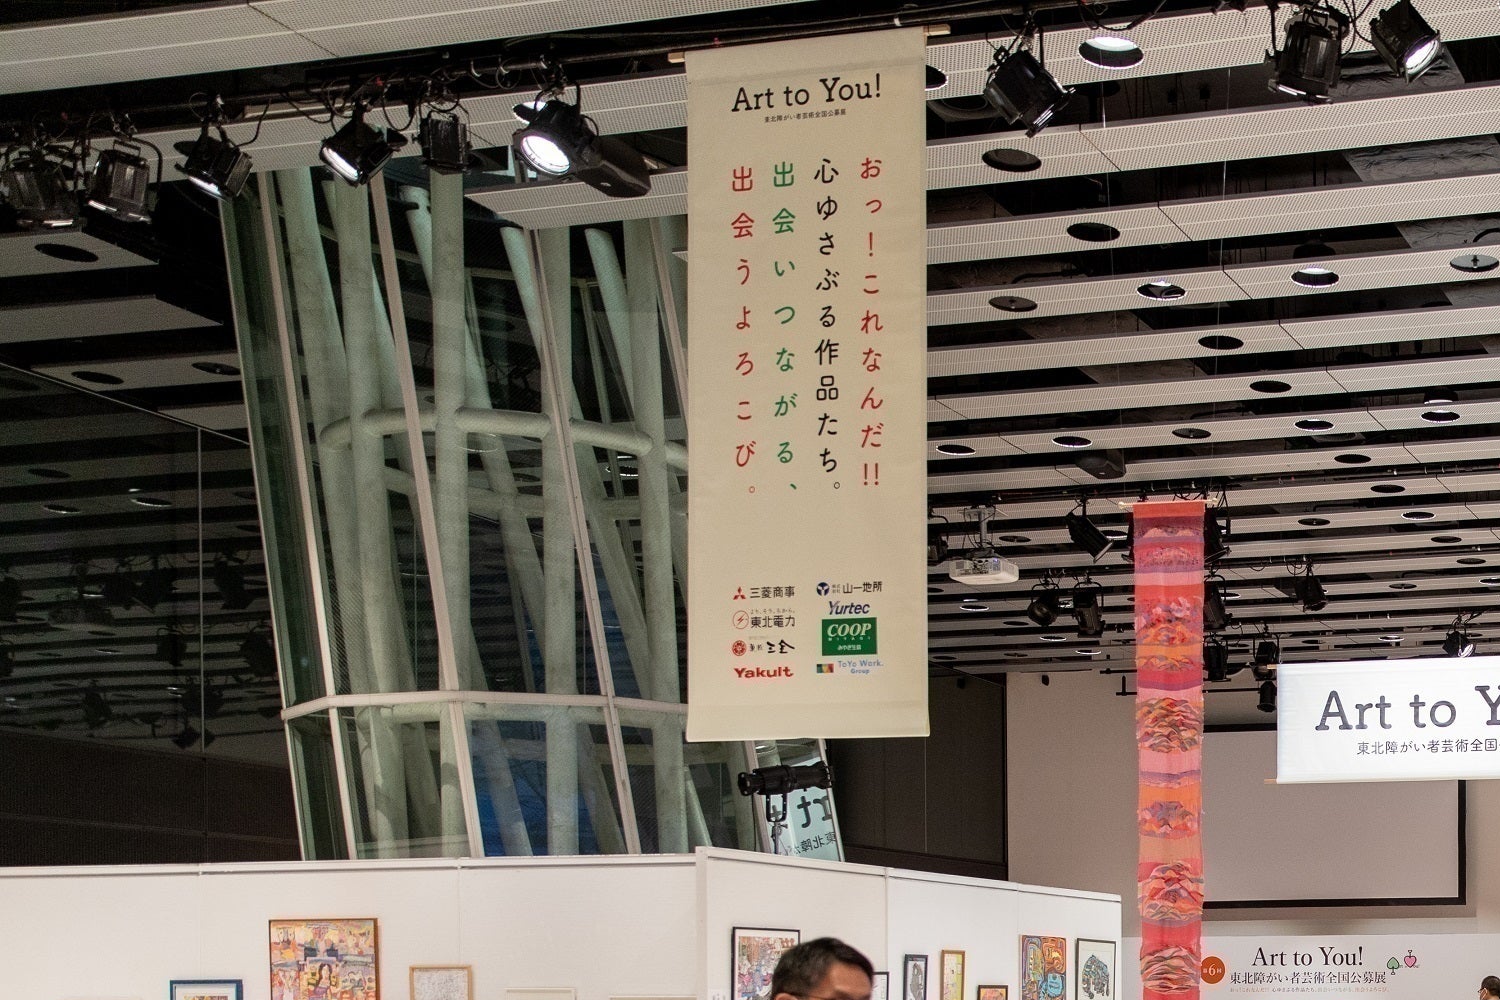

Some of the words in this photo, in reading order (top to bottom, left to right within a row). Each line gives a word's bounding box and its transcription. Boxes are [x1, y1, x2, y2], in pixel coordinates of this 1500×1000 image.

[731, 86, 775, 113] Art
[783, 84, 810, 107] to
[820, 73, 882, 101] You!
[731, 165, 756, 494] 出会うよろこび。
[773, 161, 797, 489] 出会いつながる、
[814, 157, 840, 490] 心ゆさぶる作品たち。
[750, 585, 795, 599] 三菱商事
[829, 600, 870, 615] Yurtec
[751, 615, 795, 628] 東北電力
[827, 622, 872, 637] COOP
[734, 666, 794, 679] Yakult
[1315, 690, 1392, 731] Art
[1409, 694, 1457, 728] to
[1252, 947, 1287, 966] Art
[1293, 950, 1312, 966] to
[1319, 946, 1364, 966] You!
[1230, 971, 1387, 985] 東北障がい者芸術全国公募展
